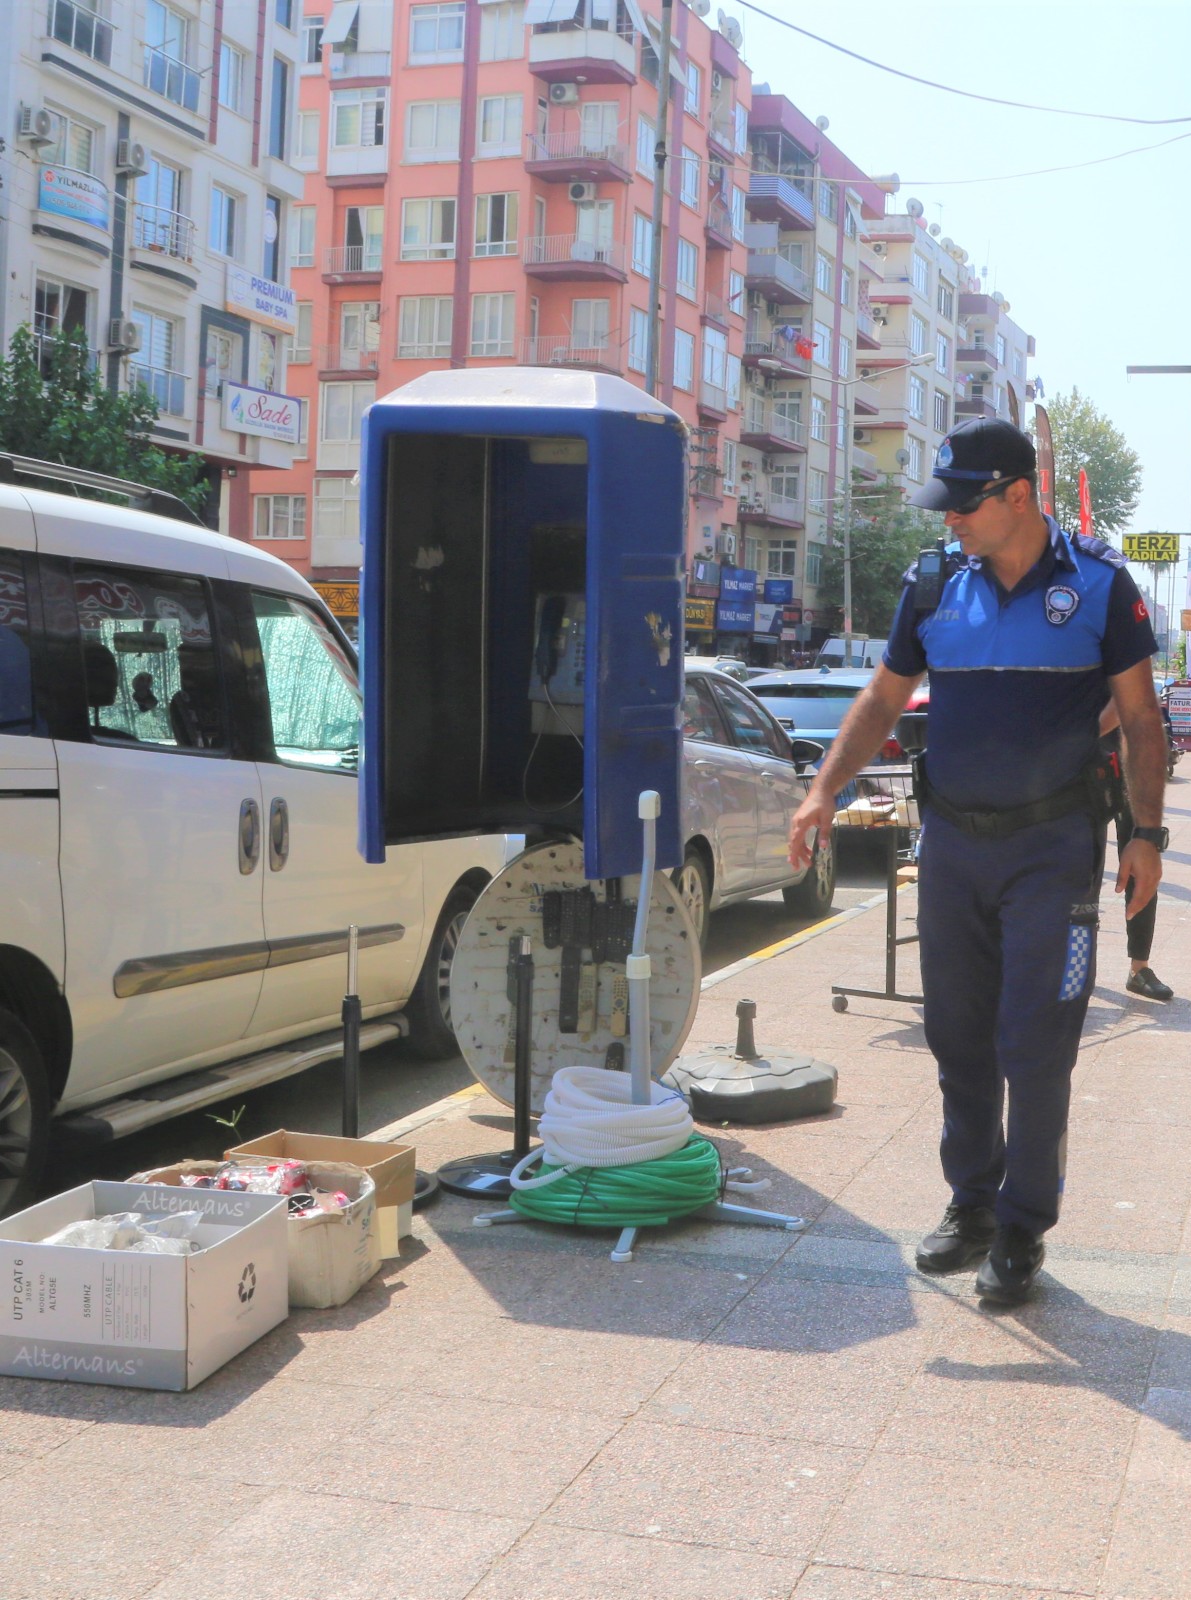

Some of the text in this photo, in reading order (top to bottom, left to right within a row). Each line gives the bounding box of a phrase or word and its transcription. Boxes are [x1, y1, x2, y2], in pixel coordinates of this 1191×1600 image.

[251, 276, 293, 305] PREMIUM
[255, 297, 288, 319] BABY SPA
[248, 395, 292, 425] Sade
[724, 579, 738, 590] YILMAZ
[739, 582, 754, 591] MARKET
[736, 612, 752, 622] MARKET
[132, 1189, 246, 1217] Alternans
[14, 1269, 23, 1294] CAT
[13, 1296, 23, 1320] UTP
[83, 1284, 92, 1318] 550MHZ
[105, 1276, 113, 1325] UTP CABLE
[12, 1345, 137, 1376] Alternans
